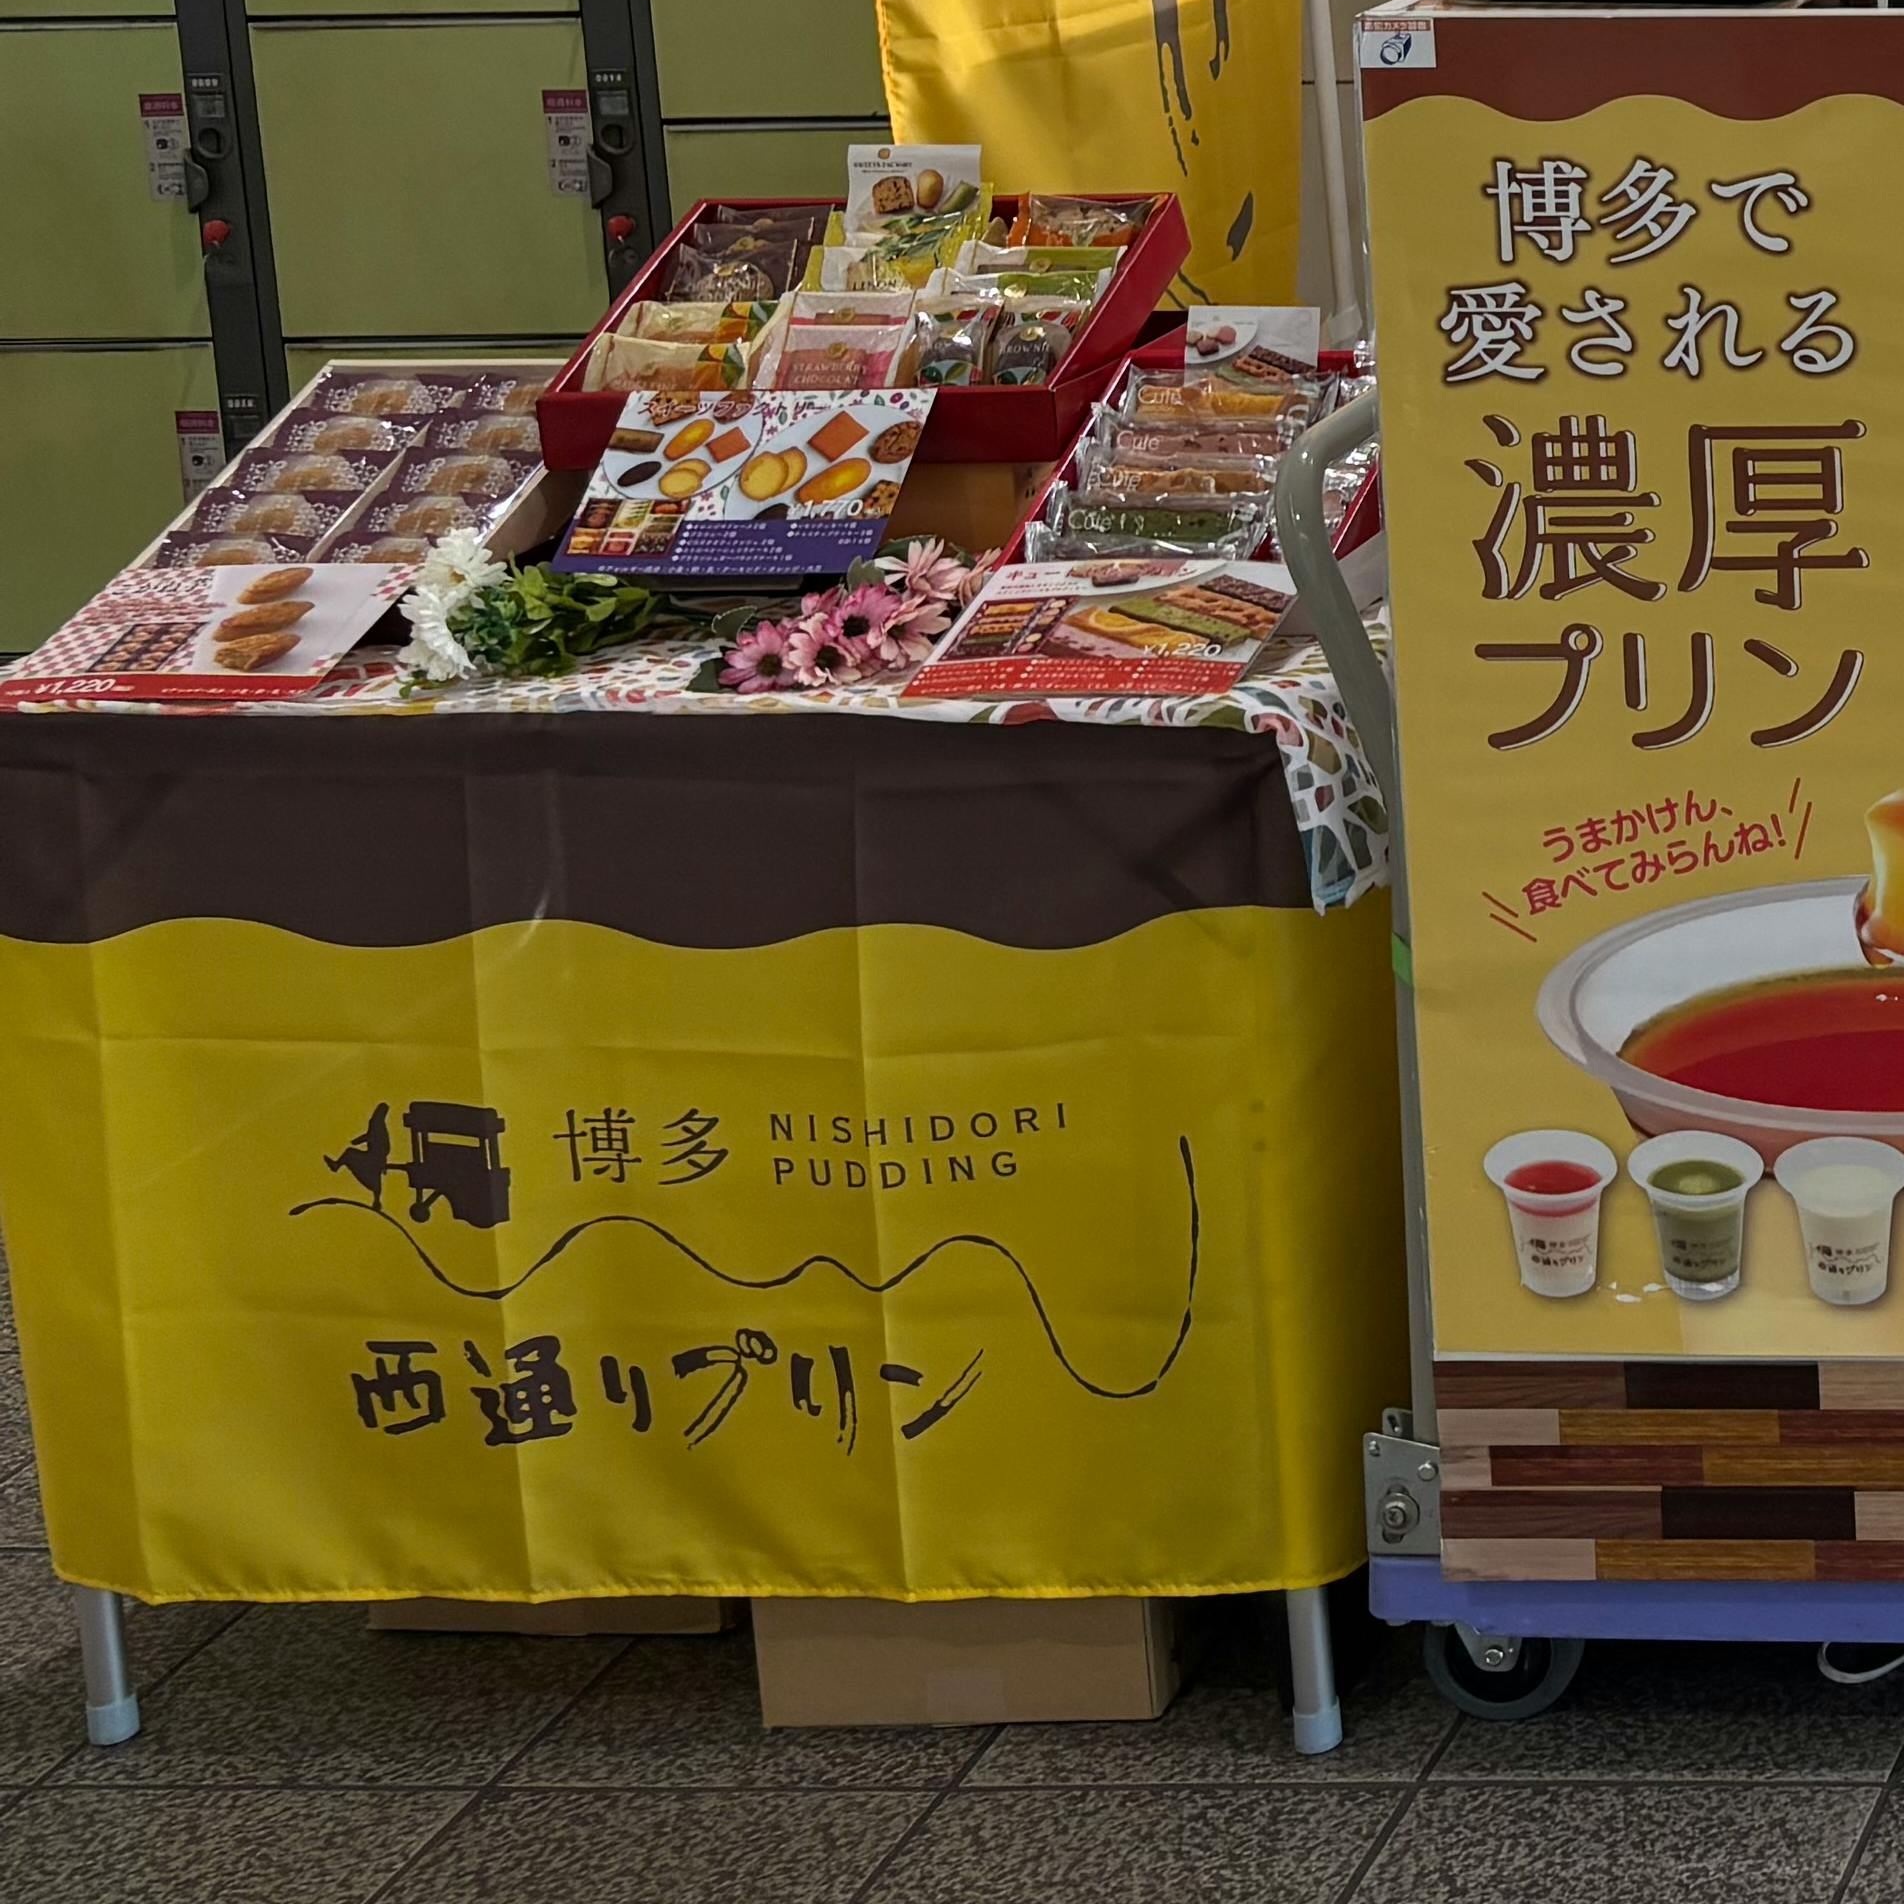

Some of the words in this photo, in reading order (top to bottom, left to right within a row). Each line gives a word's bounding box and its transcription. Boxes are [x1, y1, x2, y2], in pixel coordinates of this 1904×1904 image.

[1485, 157, 1811, 265] 博多で
[1439, 280, 1859, 385] 愛される
[1464, 411, 1872, 612] 濃厚
[1473, 625, 1867, 753] プリン
[1520, 812, 1788, 916] 食べてみらんね!
[1541, 789, 1736, 862] うまかけん、
[552, 1103, 731, 1189] 博多
[767, 1101, 1071, 1147] NISHIDORI
[770, 1153, 1021, 1191] PUDDING
[351, 1327, 986, 1457] 西通りプリン
